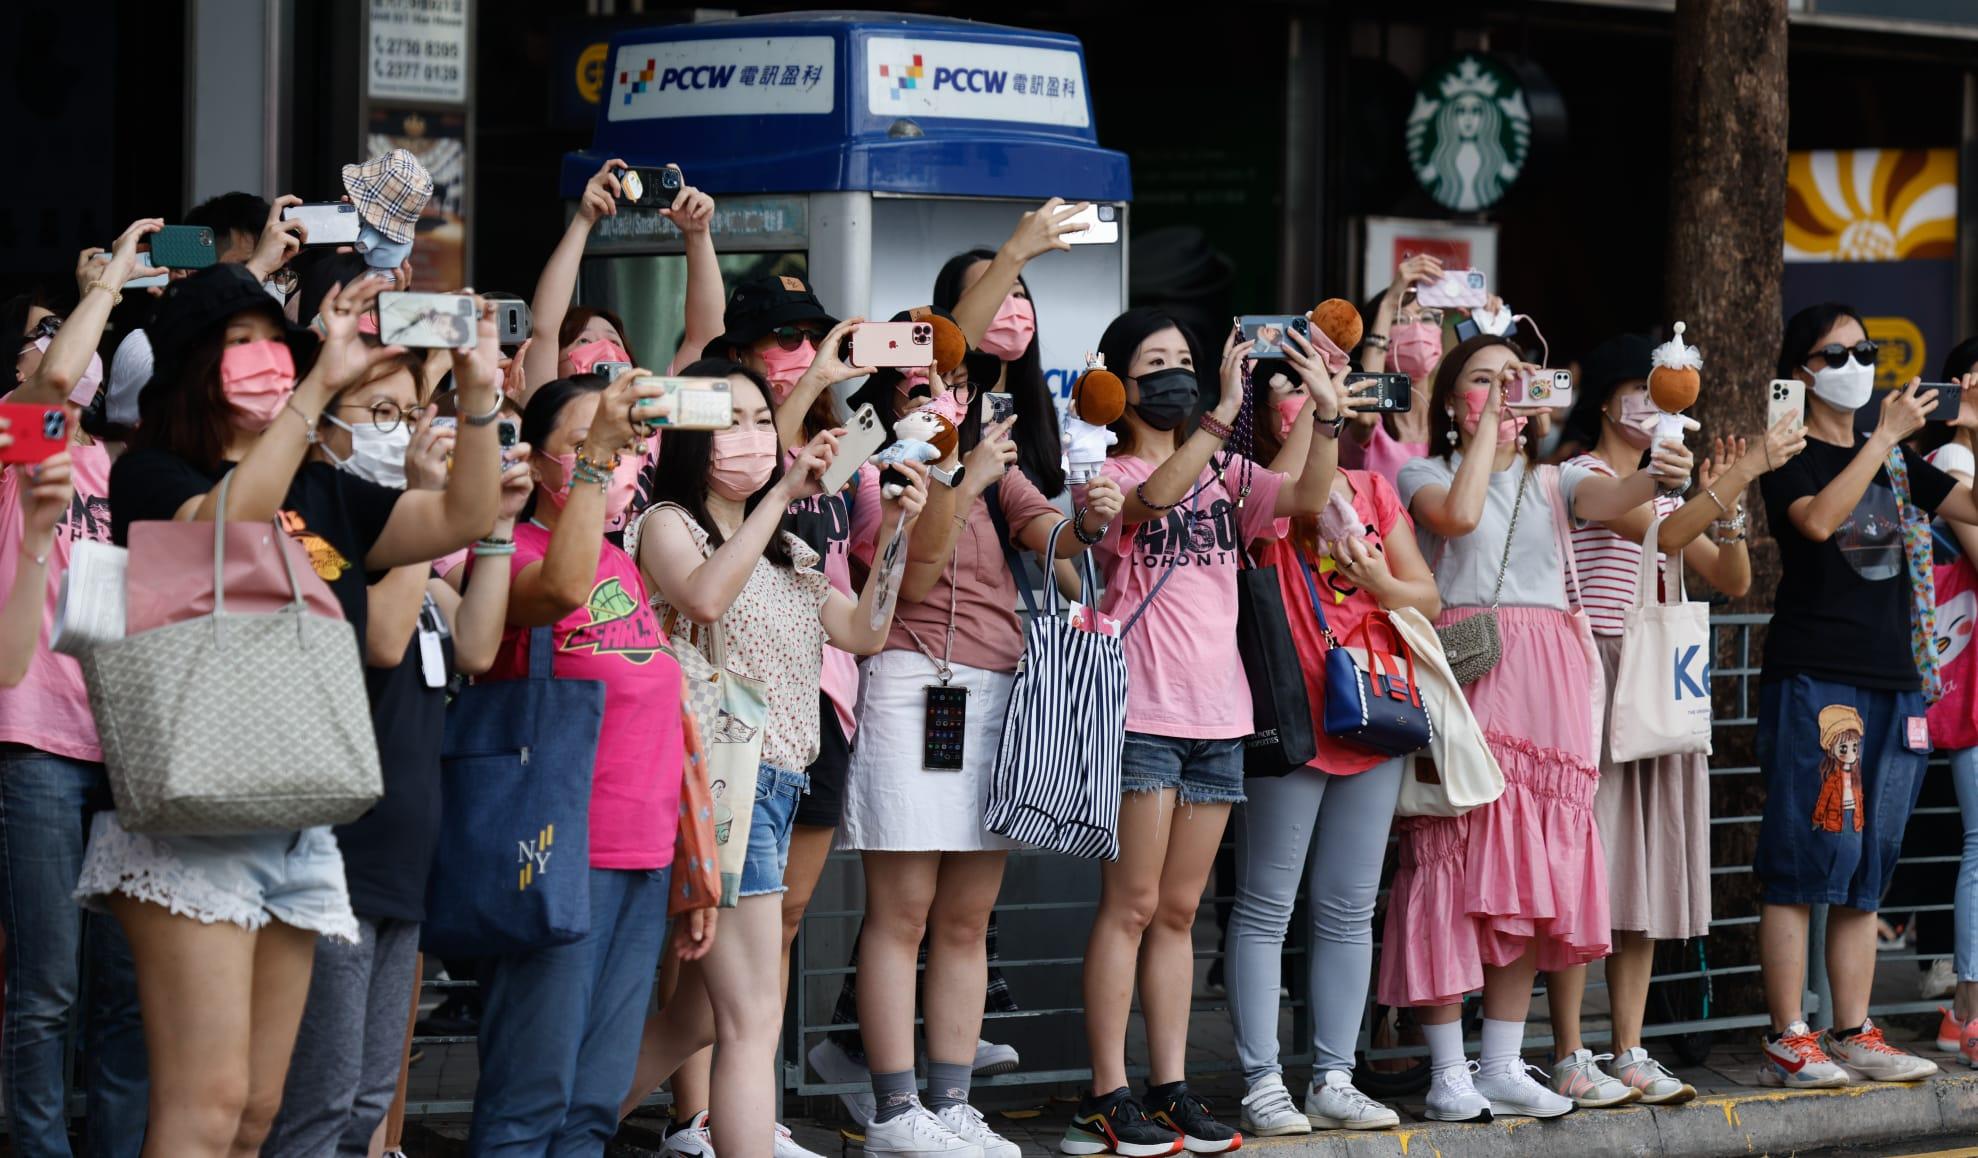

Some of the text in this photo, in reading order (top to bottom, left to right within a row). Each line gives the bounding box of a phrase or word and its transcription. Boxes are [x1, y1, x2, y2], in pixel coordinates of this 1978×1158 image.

[659, 64, 823, 92] PCCW 電訊盈科
[933, 67, 1076, 99] PCCW 電訊盈科
